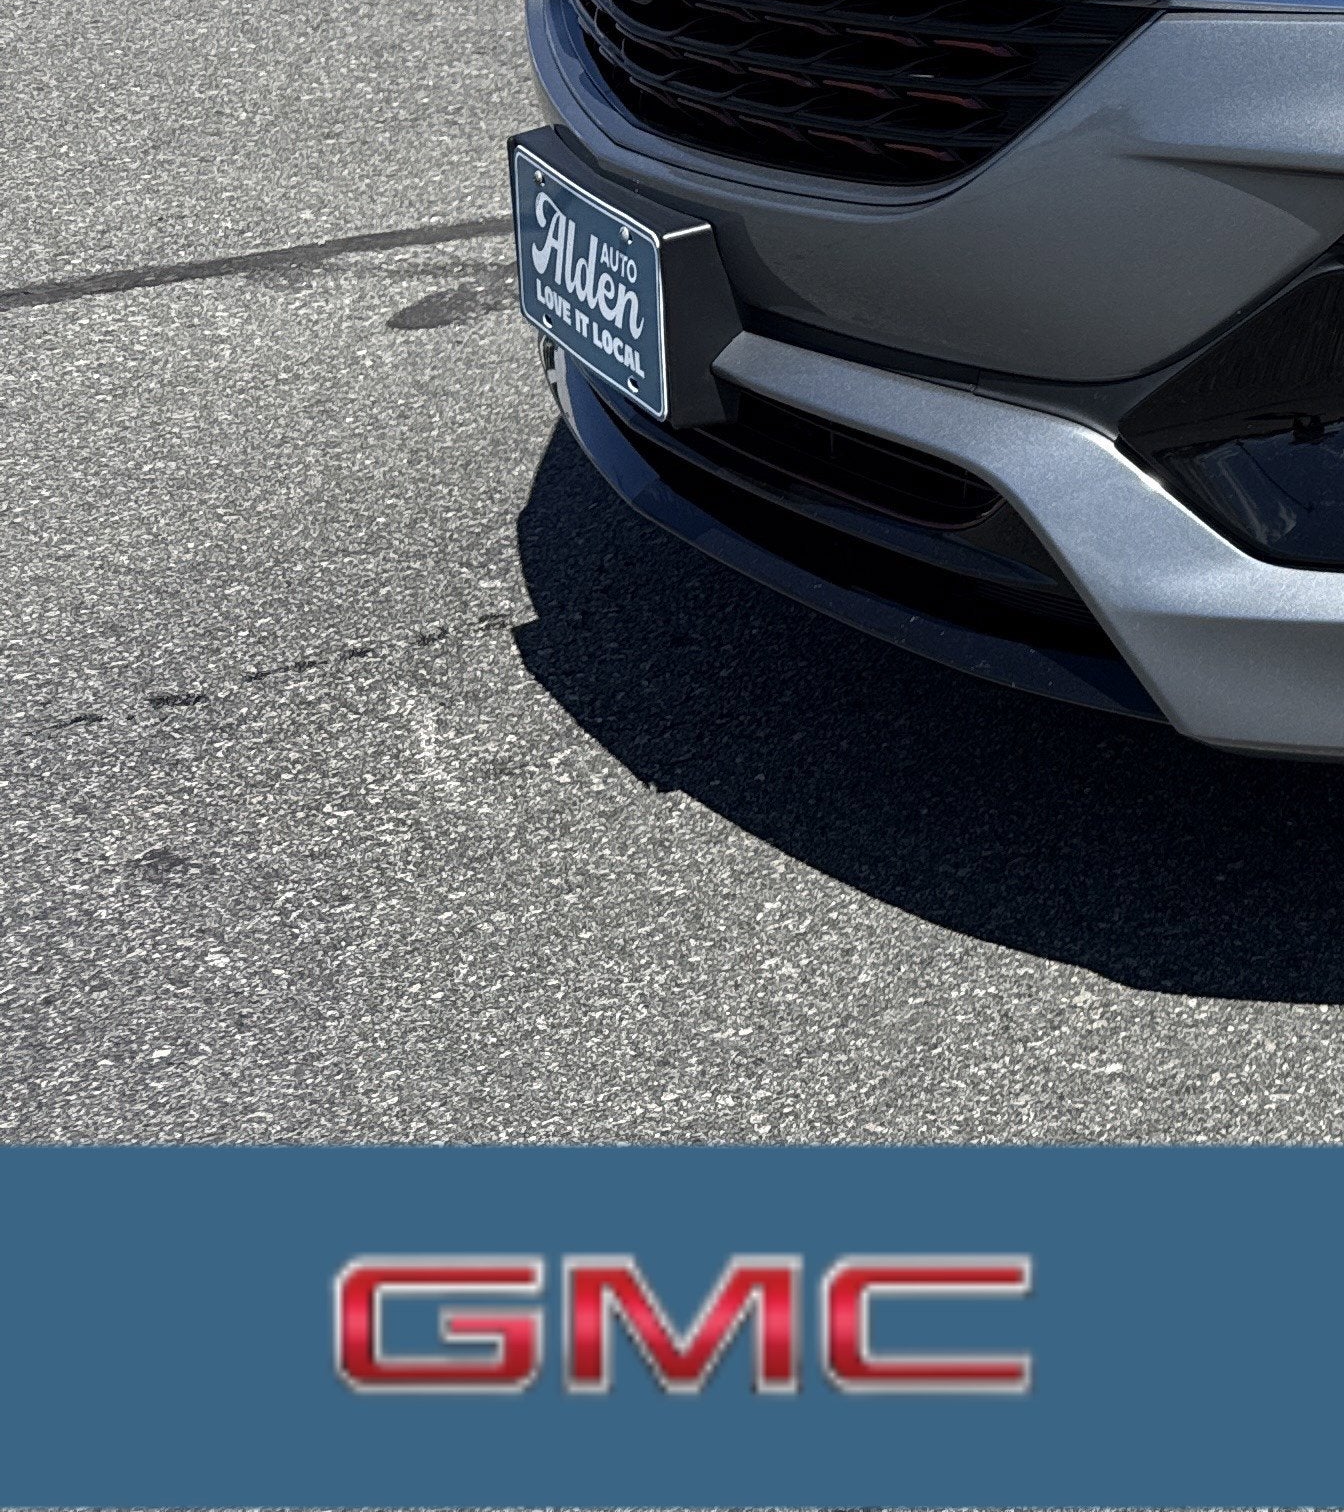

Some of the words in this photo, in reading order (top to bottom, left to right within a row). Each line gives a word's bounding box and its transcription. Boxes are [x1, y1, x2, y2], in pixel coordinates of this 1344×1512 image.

[532, 191, 645, 340] Alden
[600, 243, 637, 283] AUTO
[536, 278, 571, 326] LOVE
[575, 308, 589, 338] IT
[593, 321, 645, 379] LOCAL
